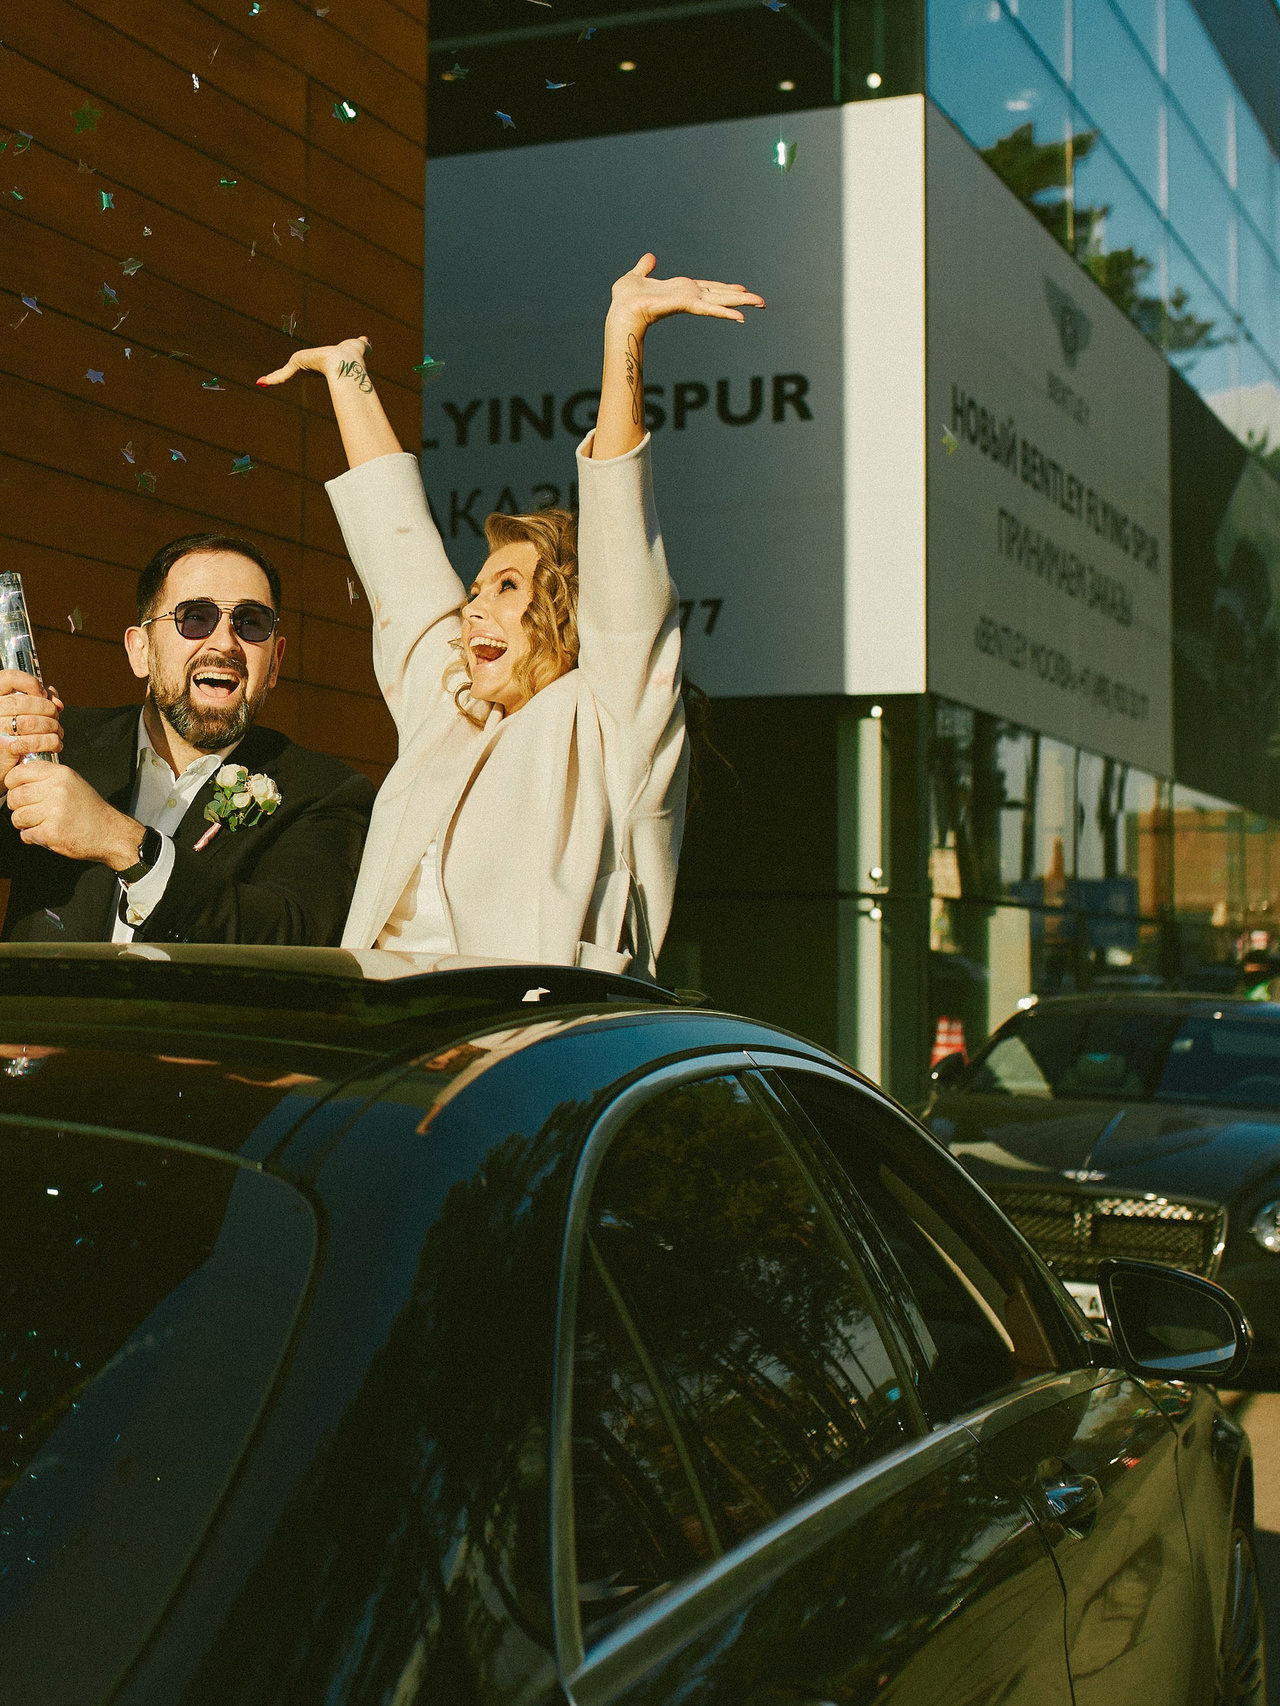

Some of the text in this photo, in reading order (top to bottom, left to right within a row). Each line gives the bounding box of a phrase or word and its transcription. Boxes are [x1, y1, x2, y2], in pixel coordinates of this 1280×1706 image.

[644, 373, 813, 432] SPUR
[951, 382, 1018, 475] НОВЫЙ
[1021, 437, 1084, 521] BENTLEY
